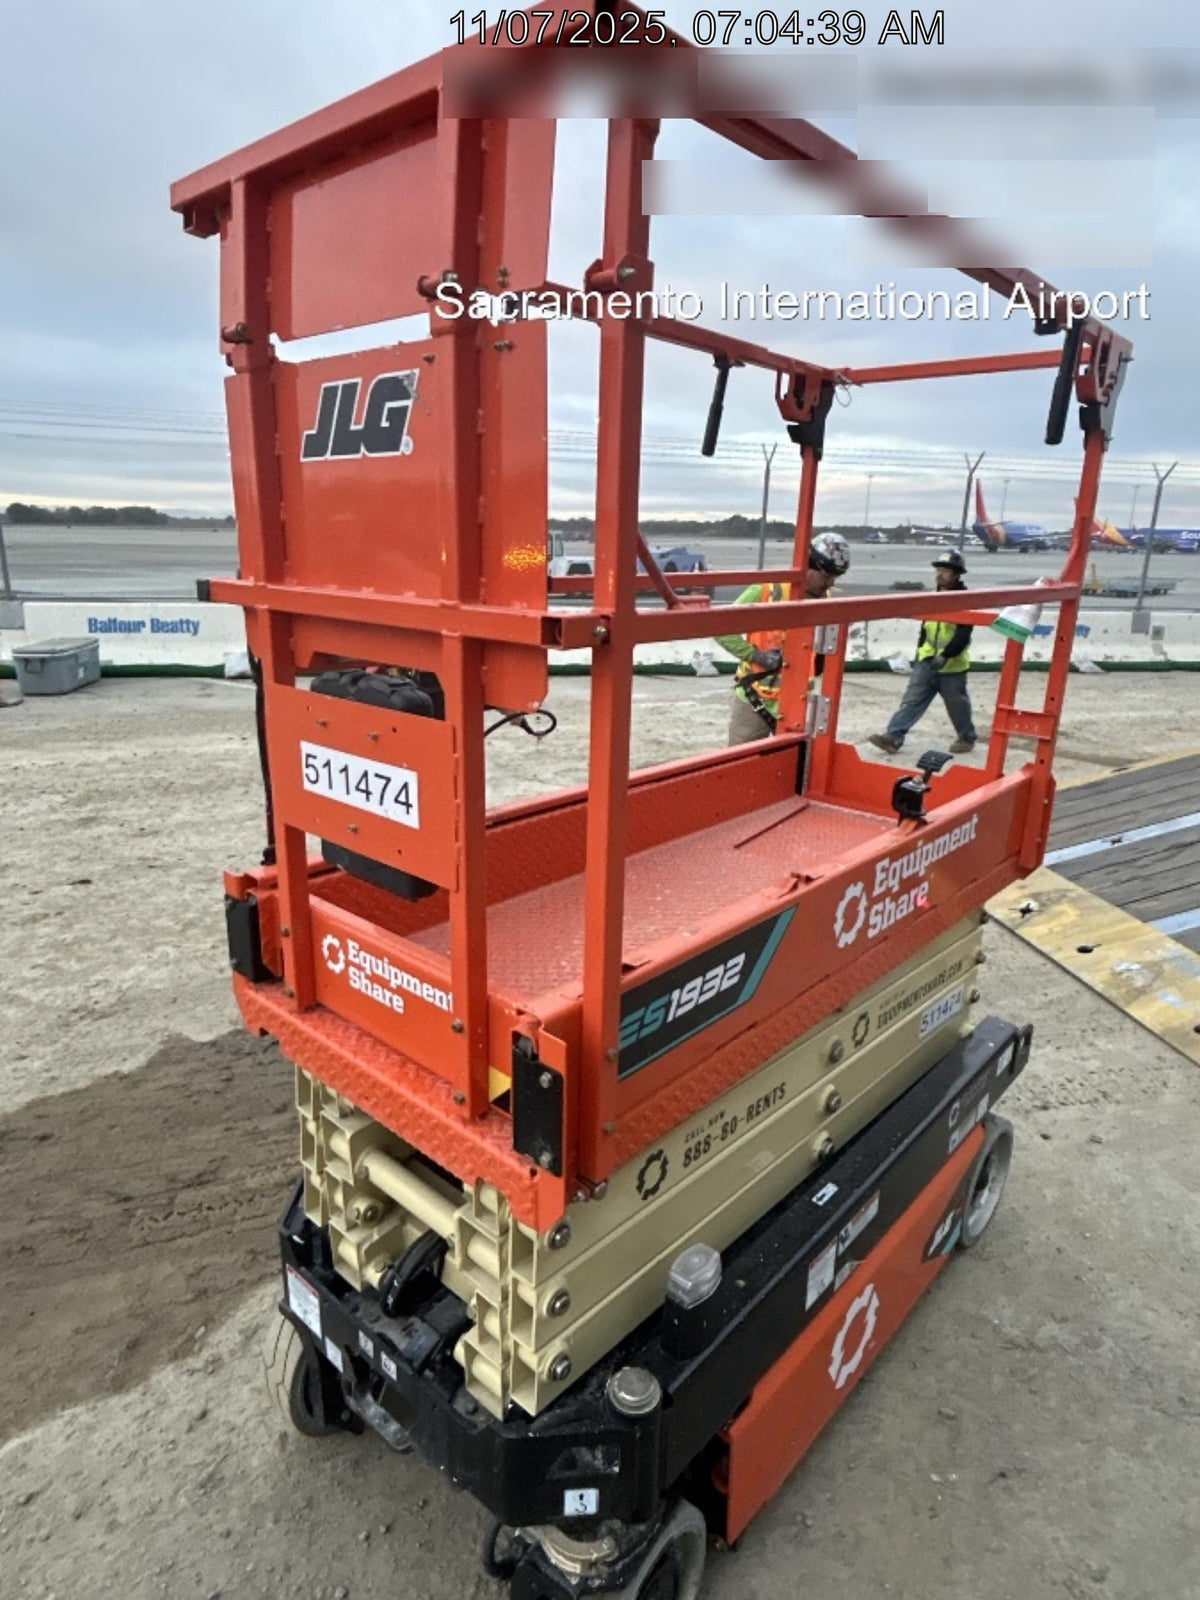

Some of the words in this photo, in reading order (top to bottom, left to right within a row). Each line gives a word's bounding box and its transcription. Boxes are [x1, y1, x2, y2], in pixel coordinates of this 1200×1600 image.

[301, 369, 419, 461] JLG
[87, 617, 146, 633] Balfour
[150, 618, 199, 636] Beatty
[305, 753, 413, 815] 511474
[872, 813, 978, 897] Equipment
[867, 881, 929, 938] Share
[348, 965, 404, 1014] Share
[919, 990, 962, 1033] 511474
[683, 1082, 787, 1169] 888-80-RENTS
